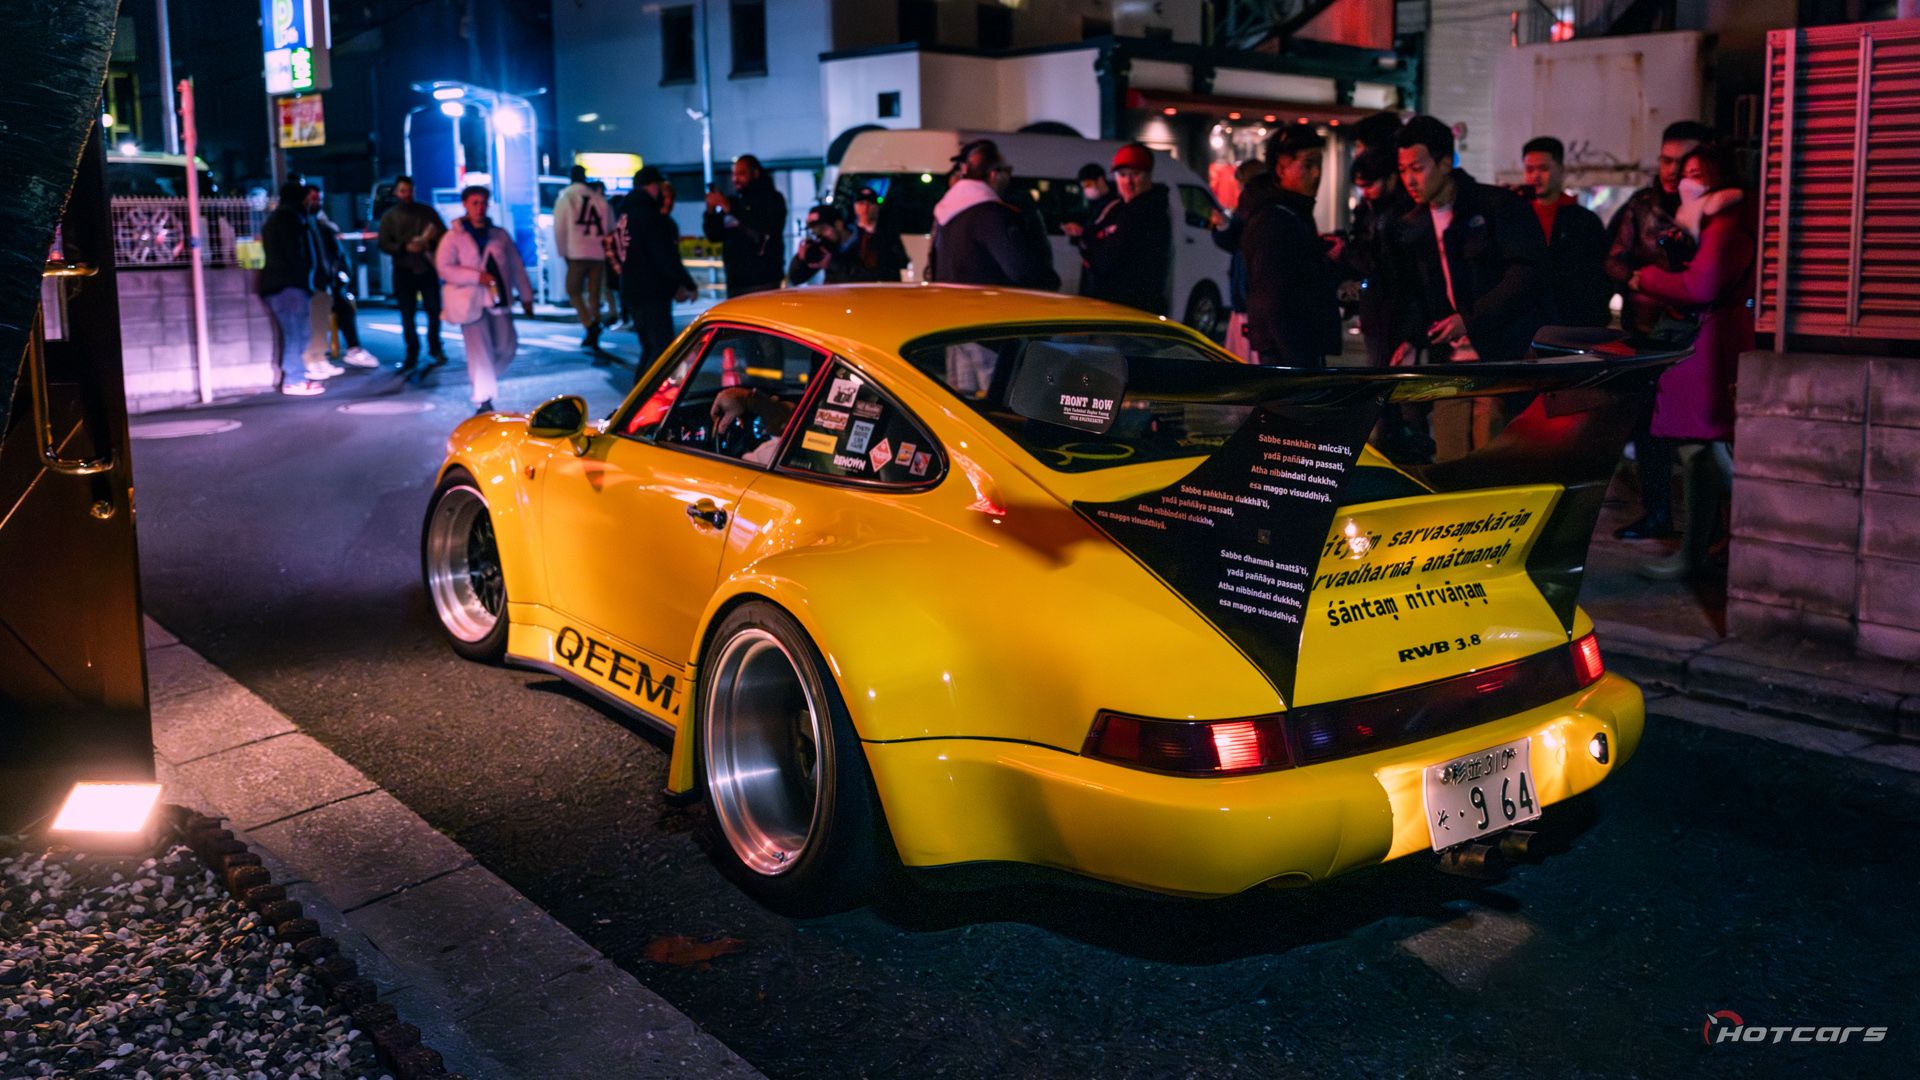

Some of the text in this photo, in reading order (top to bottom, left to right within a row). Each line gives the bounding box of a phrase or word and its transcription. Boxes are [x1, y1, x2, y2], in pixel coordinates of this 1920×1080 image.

[575, 195, 605, 236] LA
[1060, 394, 1114, 411] FRONT ROW
[1259, 434, 1281, 444] Sabbe
[833, 454, 867, 471] RENOWN
[1315, 460, 1345, 473] passati,
[1251, 465, 1338, 488] Atha nibbindati dukkhe,
[1181, 485, 1201, 495] Sabbe
[1249, 482, 1262, 490] esa
[1263, 484, 1288, 496] maggo
[1208, 505, 1235, 517] passati,
[1188, 514, 1215, 527] dukkhe,
[1220, 549, 1242, 561] Sabbe
[1276, 579, 1305, 593] passati,
[1218, 581, 1303, 609] Atha nibbindati dukkhe,
[1219, 599, 1231, 607] esa
[1232, 602, 1257, 613] maggo
[1398, 634, 1482, 663] RWB 3.8
[555, 626, 680, 716] QEEM
